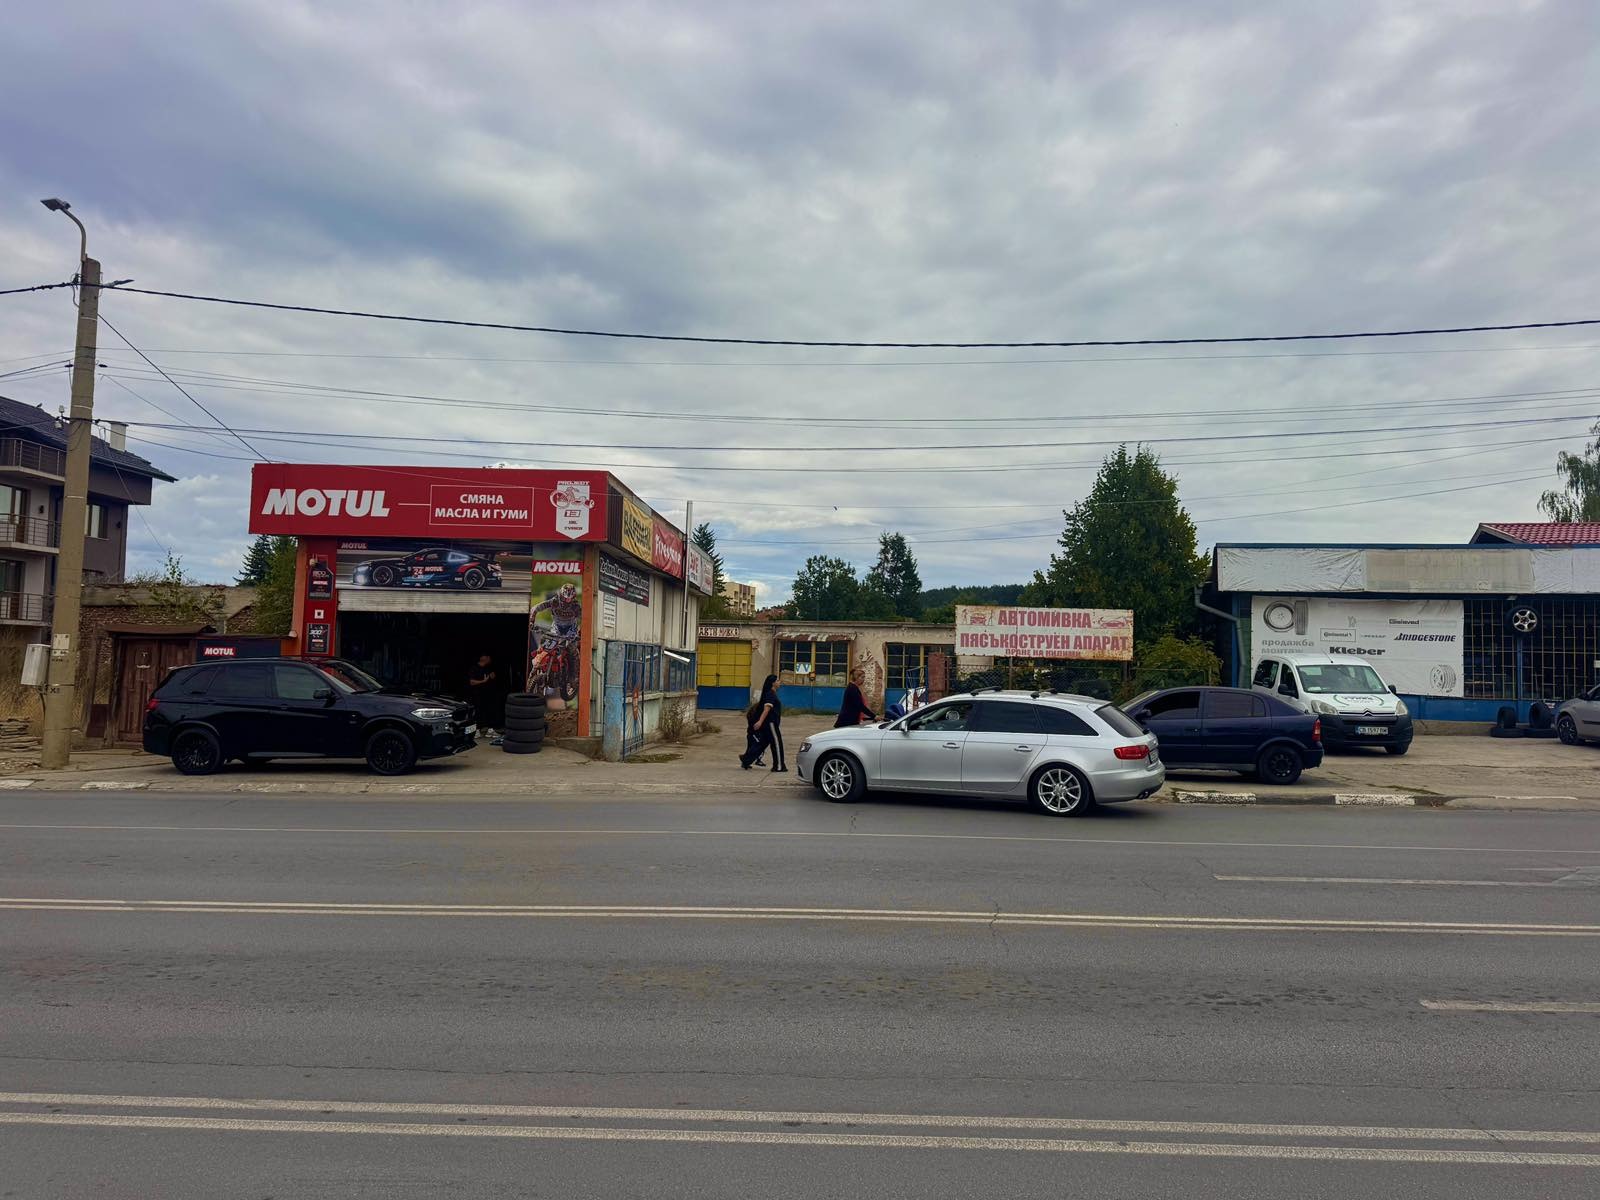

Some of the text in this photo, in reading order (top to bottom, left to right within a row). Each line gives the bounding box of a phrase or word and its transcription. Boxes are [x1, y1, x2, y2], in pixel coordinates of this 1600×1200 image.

[261, 488, 391, 517] MOTUL
[459, 493, 505, 505] СМЯНА
[434, 508, 528, 520] МАСЛА И ГУМИ
[341, 542, 368, 550] MOTUL
[533, 561, 581, 574] MOTUL
[997, 609, 1092, 629] АВТОМИВКА
[959, 633, 1129, 651] ПЯСЪКОСТРУЕН АПАРАТ
[1261, 638, 1315, 648] продажба
[1394, 632, 1457, 642] BRIDGESTONE
[204, 647, 235, 656] MOTUL
[1329, 646, 1386, 656] Kleber
